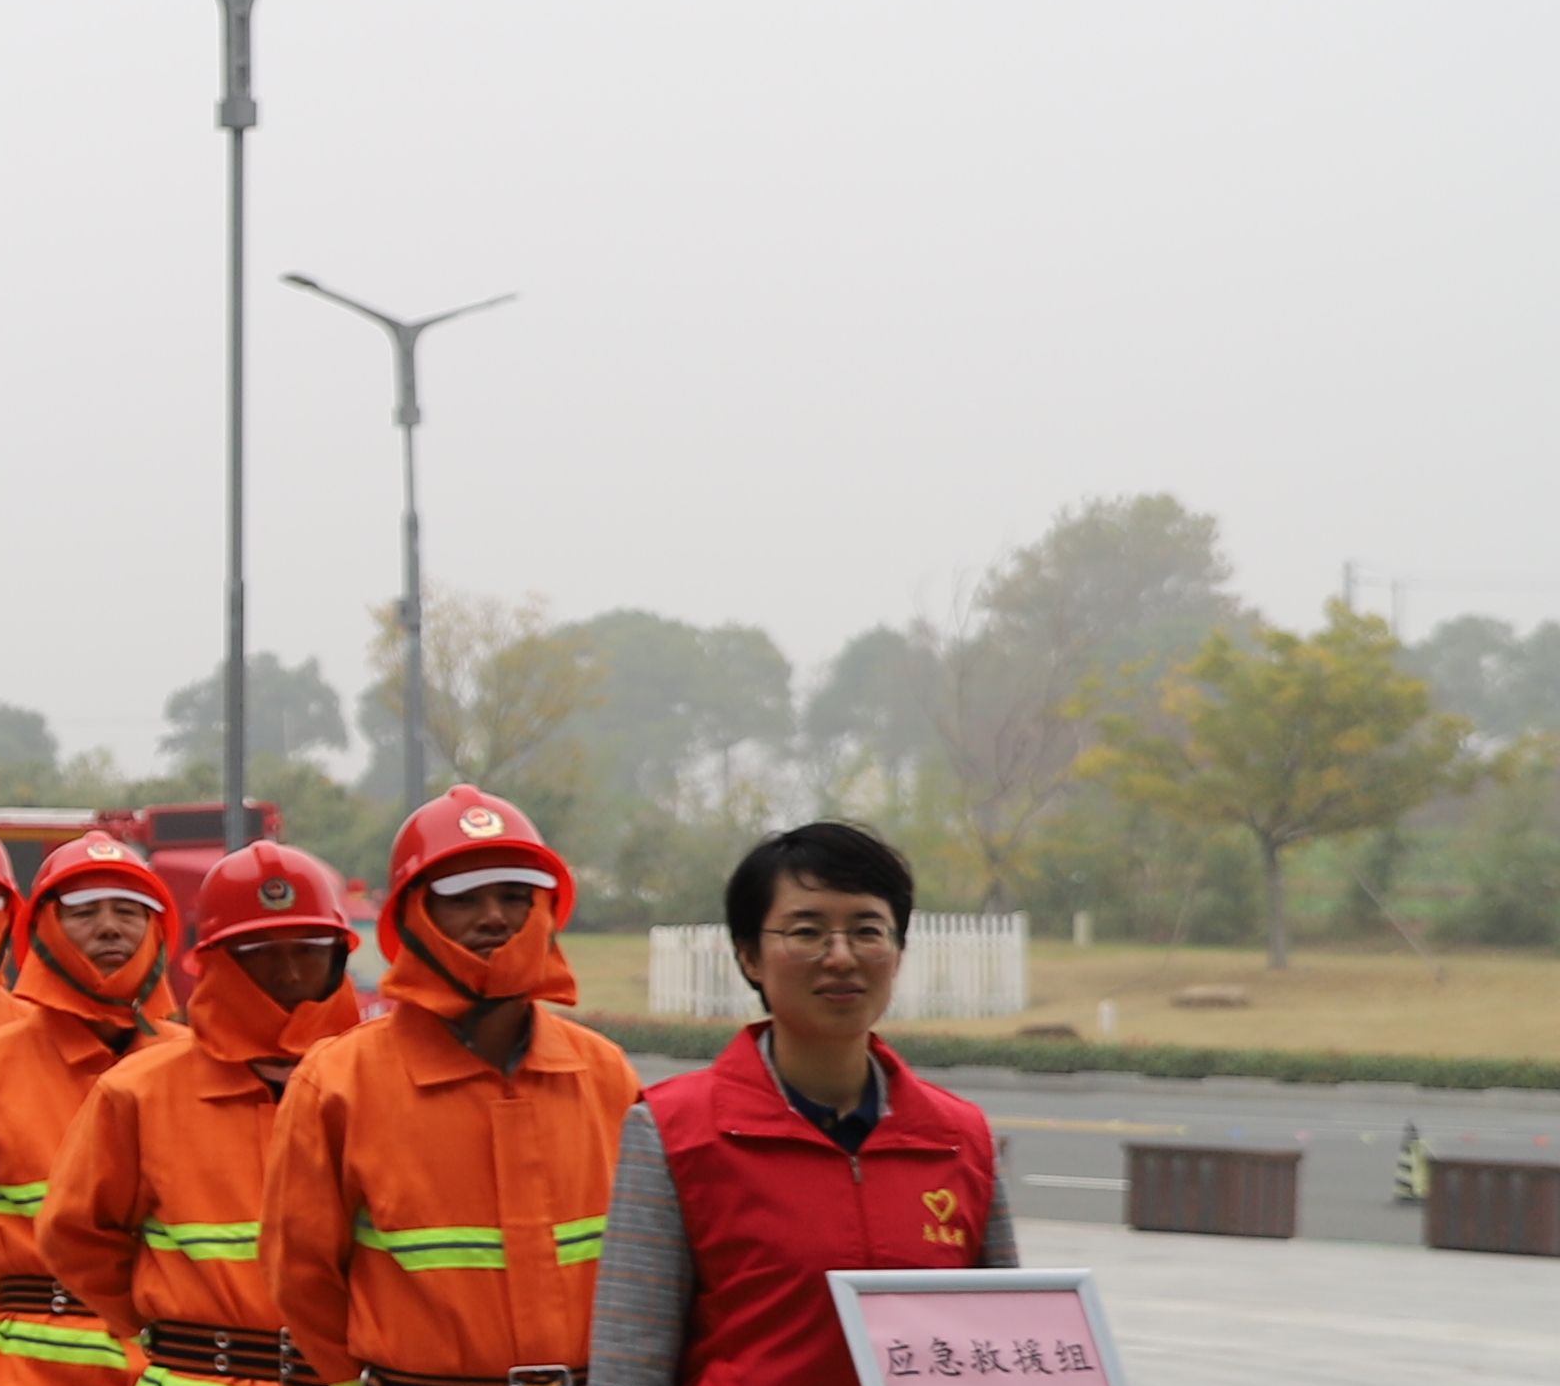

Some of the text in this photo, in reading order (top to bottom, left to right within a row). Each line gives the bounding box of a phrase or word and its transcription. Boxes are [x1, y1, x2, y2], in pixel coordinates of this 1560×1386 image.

[885, 1337, 1096, 1377] 应急救援组
